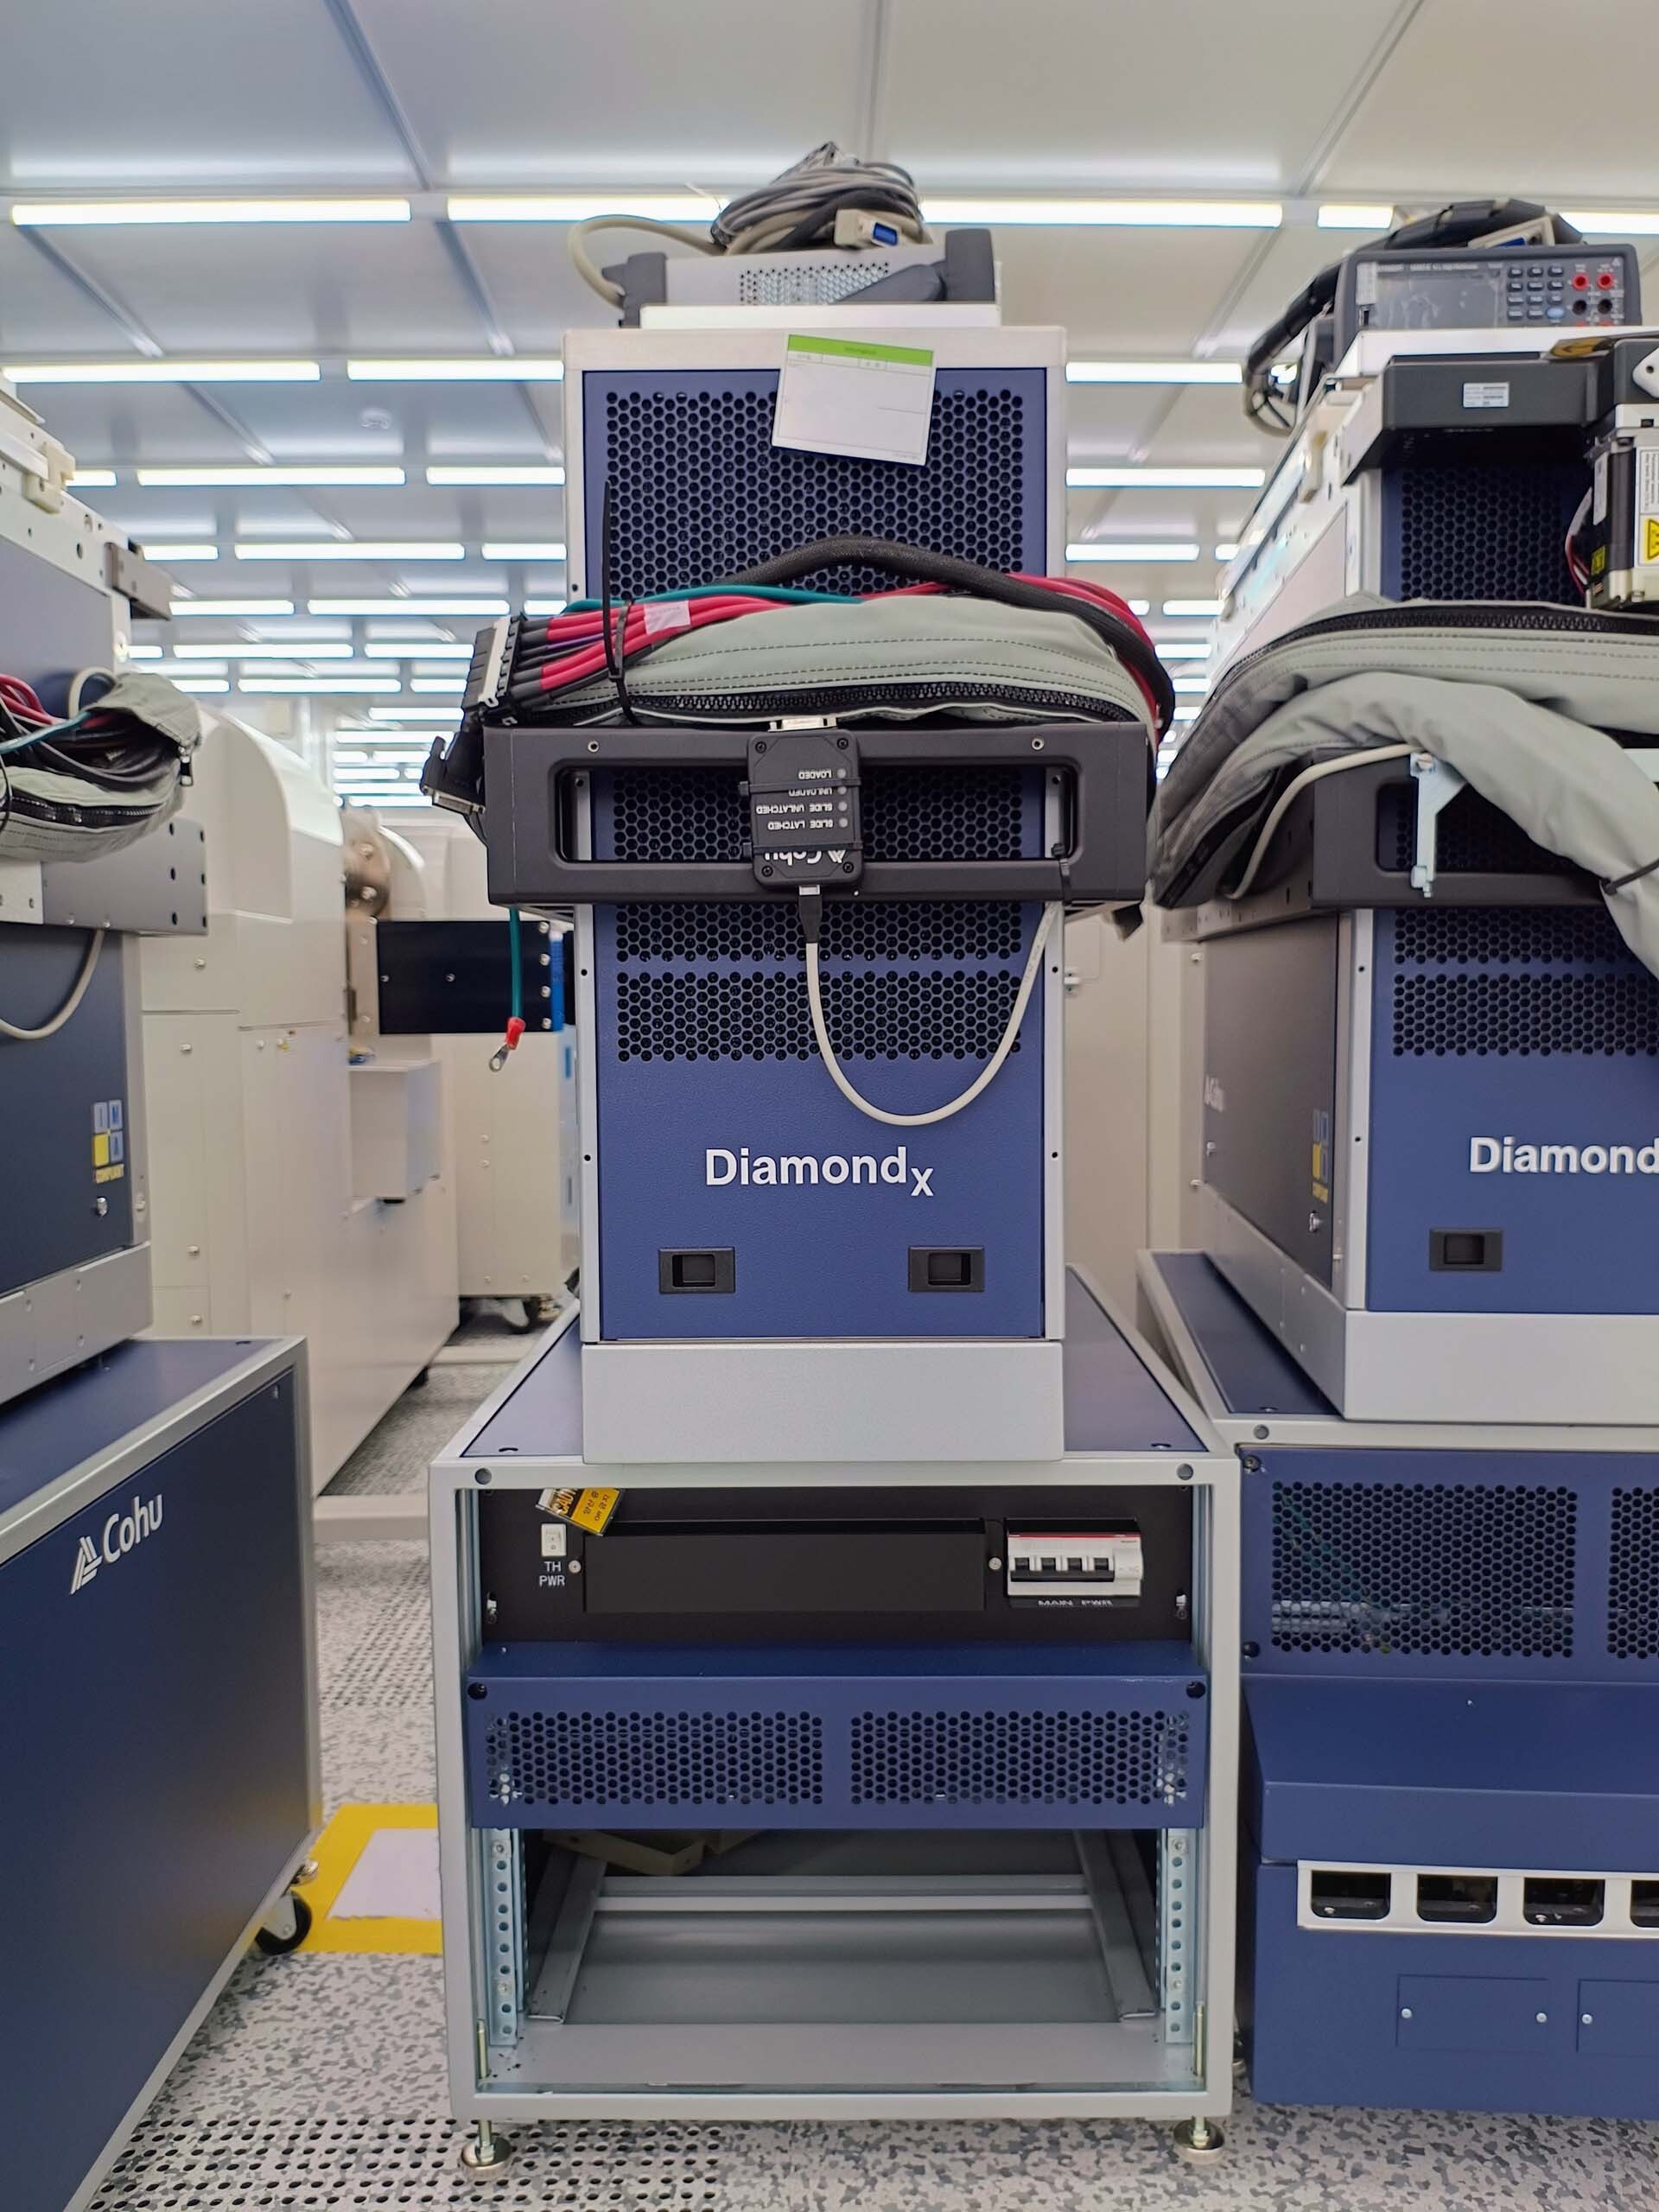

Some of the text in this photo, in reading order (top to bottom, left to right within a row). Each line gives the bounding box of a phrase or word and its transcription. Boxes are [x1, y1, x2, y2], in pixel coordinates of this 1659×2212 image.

[798, 769, 832, 779] LOADED
[788, 787, 833, 797] UNLOADED
[756, 804, 833, 815] SLIDE UNLATCHED
[767, 819, 834, 830] SLIDE LATCHED
[1469, 1136, 1659, 1174] Diamond
[552, 1488, 577, 1515] CAUT
[103, 1493, 162, 1563] Cohu
[543, 1560, 562, 1573] TH
[538, 1574, 566, 1587] PWR
